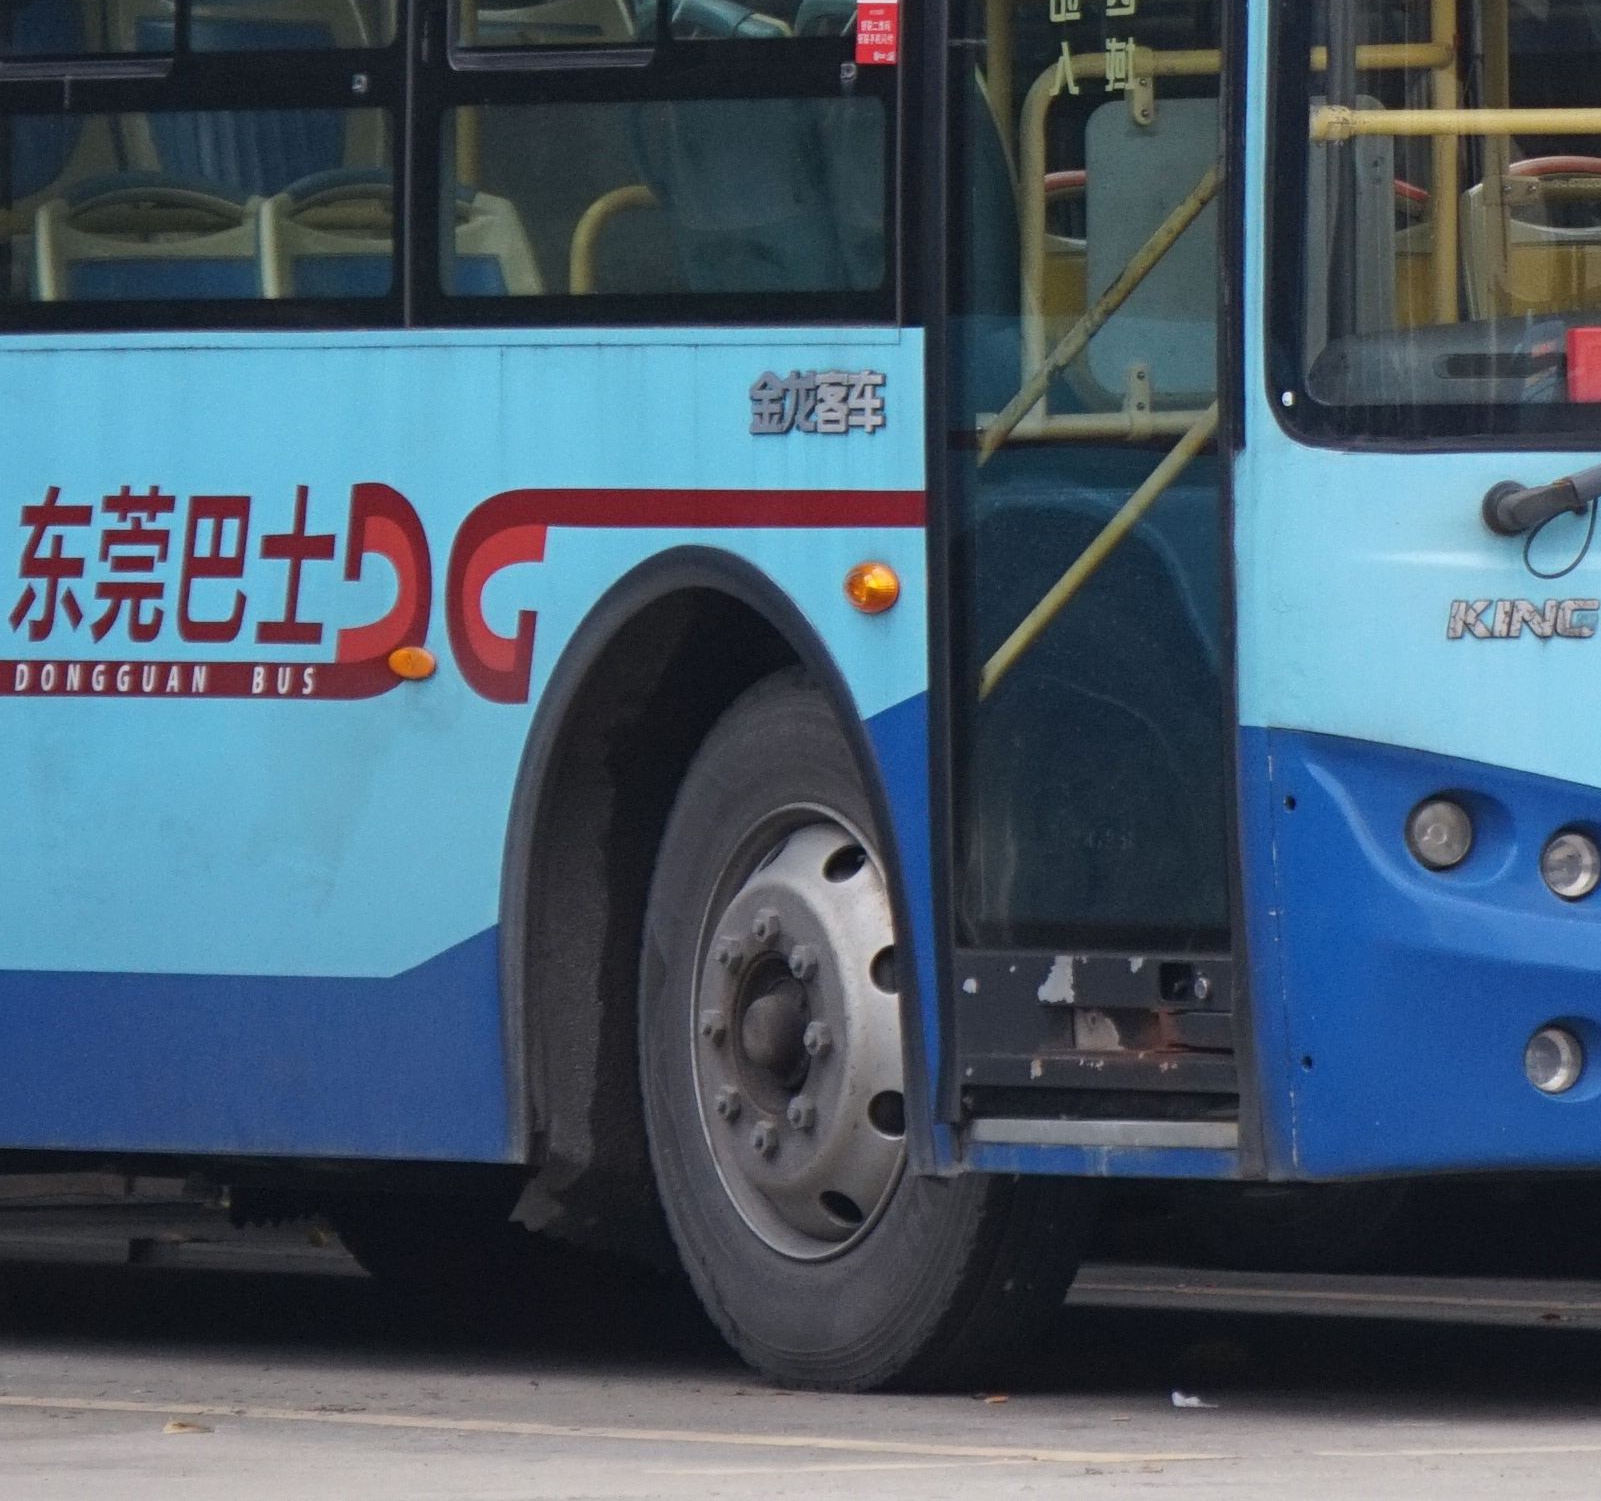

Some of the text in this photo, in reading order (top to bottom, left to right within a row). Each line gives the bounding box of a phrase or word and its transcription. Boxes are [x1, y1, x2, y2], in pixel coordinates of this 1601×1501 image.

[749, 369, 887, 435] 金龙客车
[7, 483, 337, 645] 东莞巴士
[14, 662, 316, 695] DONGGUAN BUS
